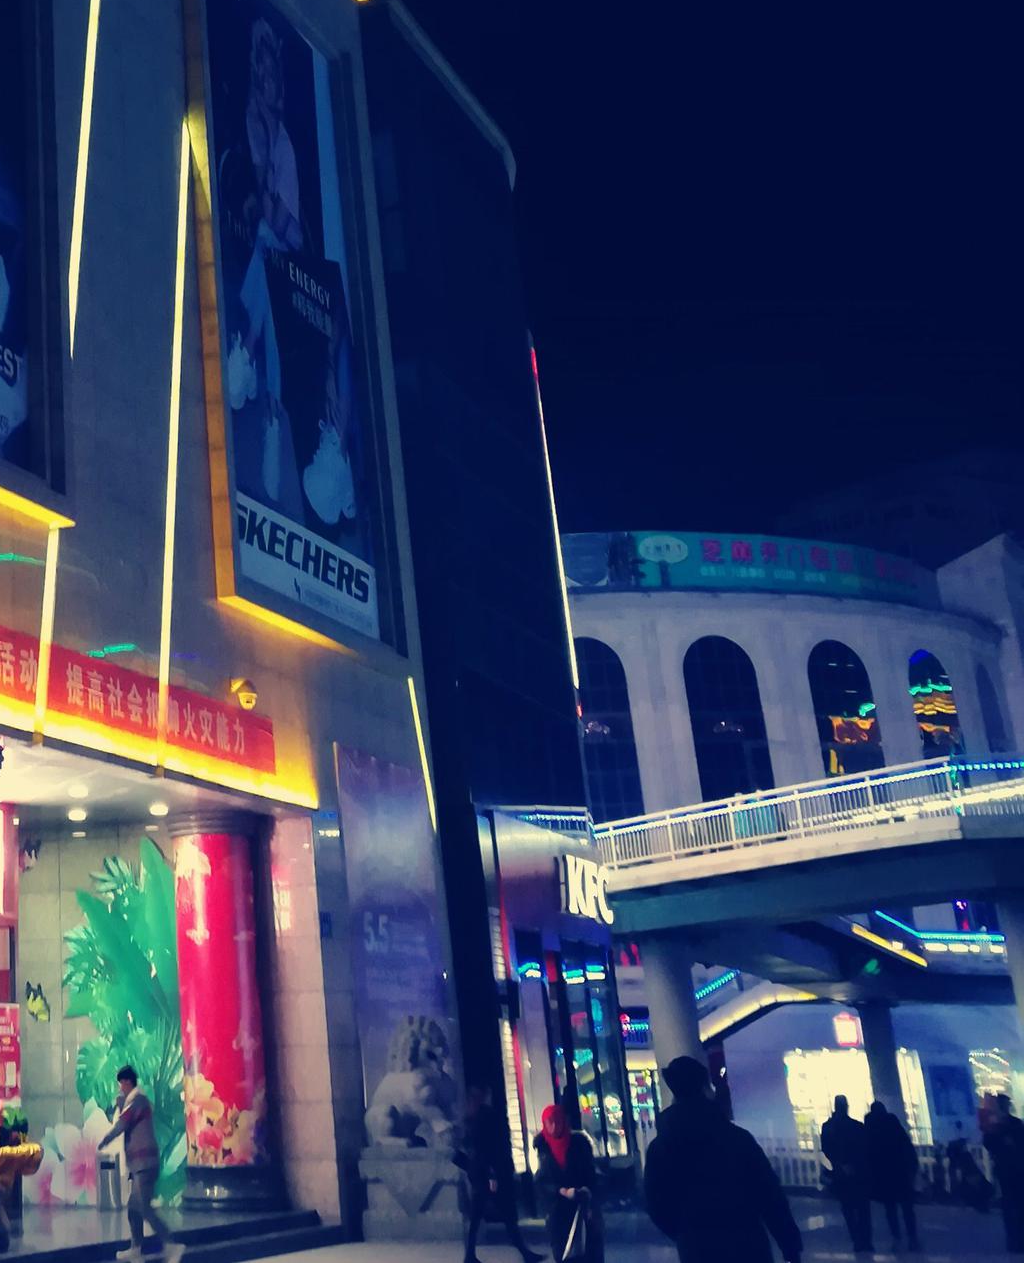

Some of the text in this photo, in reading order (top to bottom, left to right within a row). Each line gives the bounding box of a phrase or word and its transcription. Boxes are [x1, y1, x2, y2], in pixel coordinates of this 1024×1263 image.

[288, 260, 331, 310] ENERGY
[236, 503, 370, 604] SKECHERS
[566, 853, 614, 925] KFC
